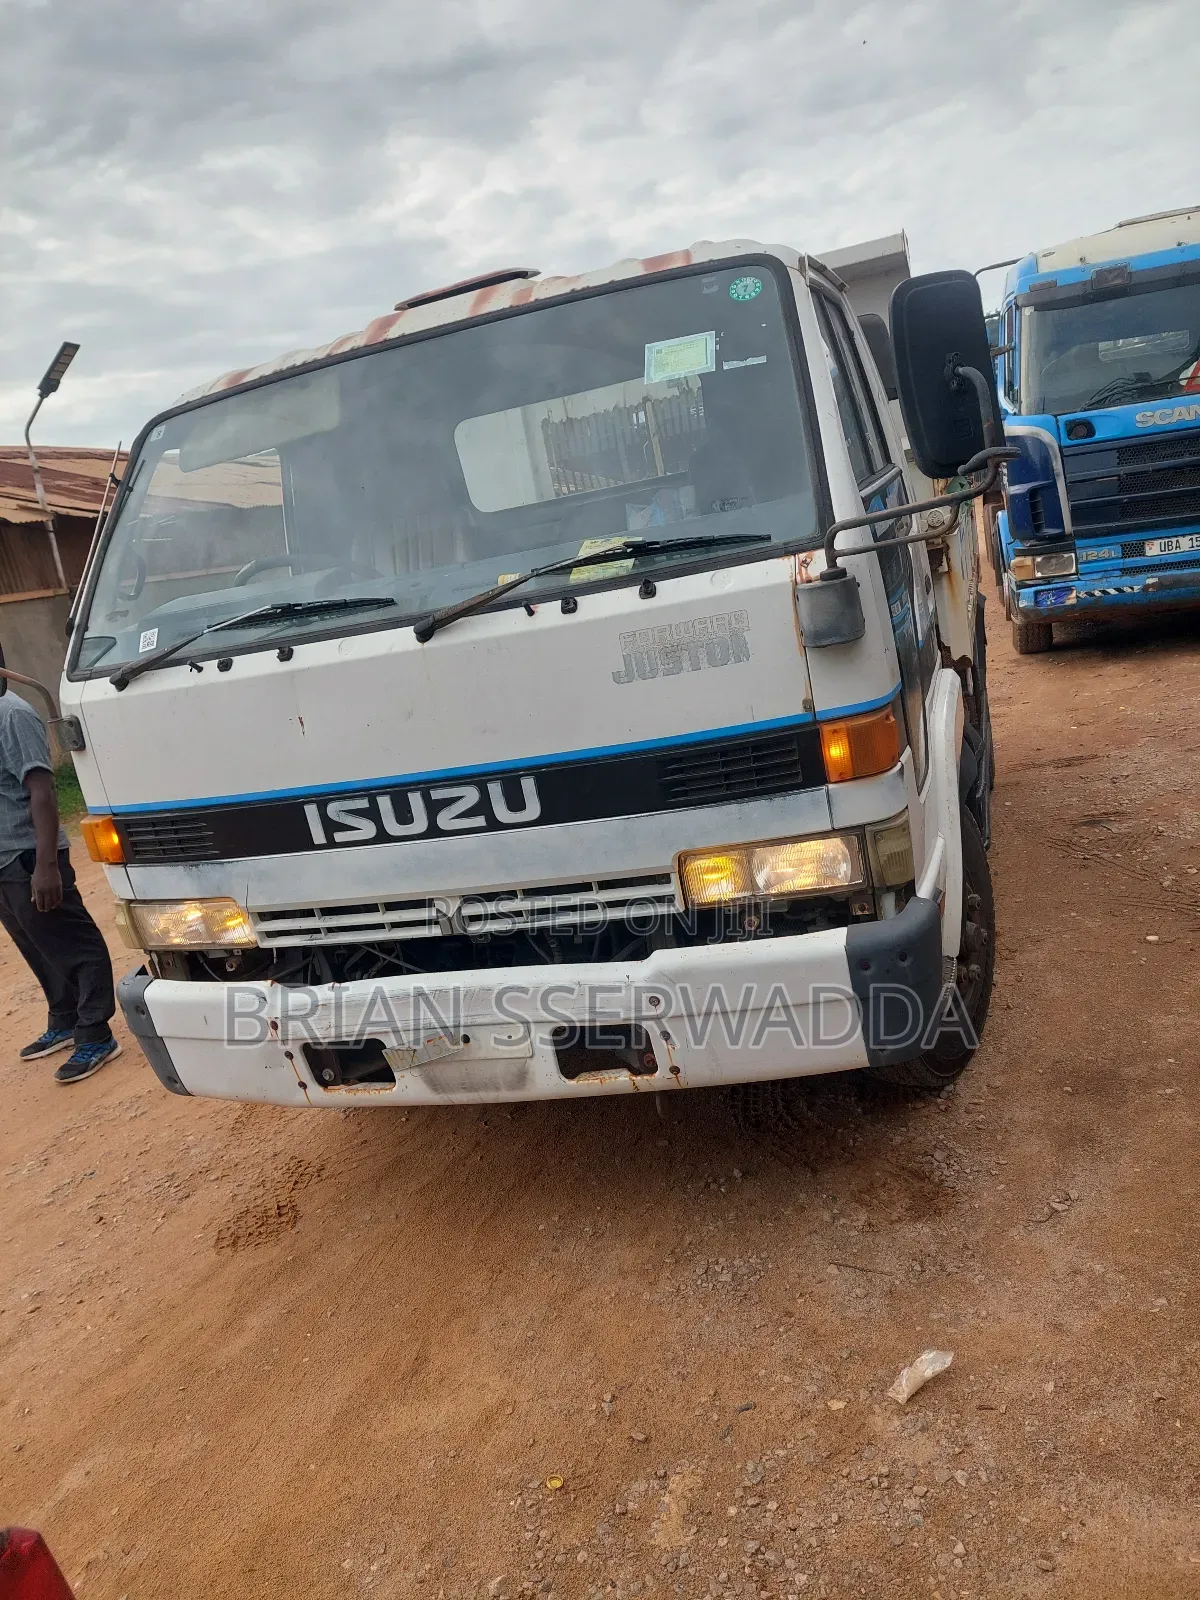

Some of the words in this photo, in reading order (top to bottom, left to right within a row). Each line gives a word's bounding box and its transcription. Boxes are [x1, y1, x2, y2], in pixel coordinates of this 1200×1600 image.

[1160, 539, 1181, 553] UBA
[611, 632, 751, 685] JUSTON
[303, 776, 542, 845] ISUZU
